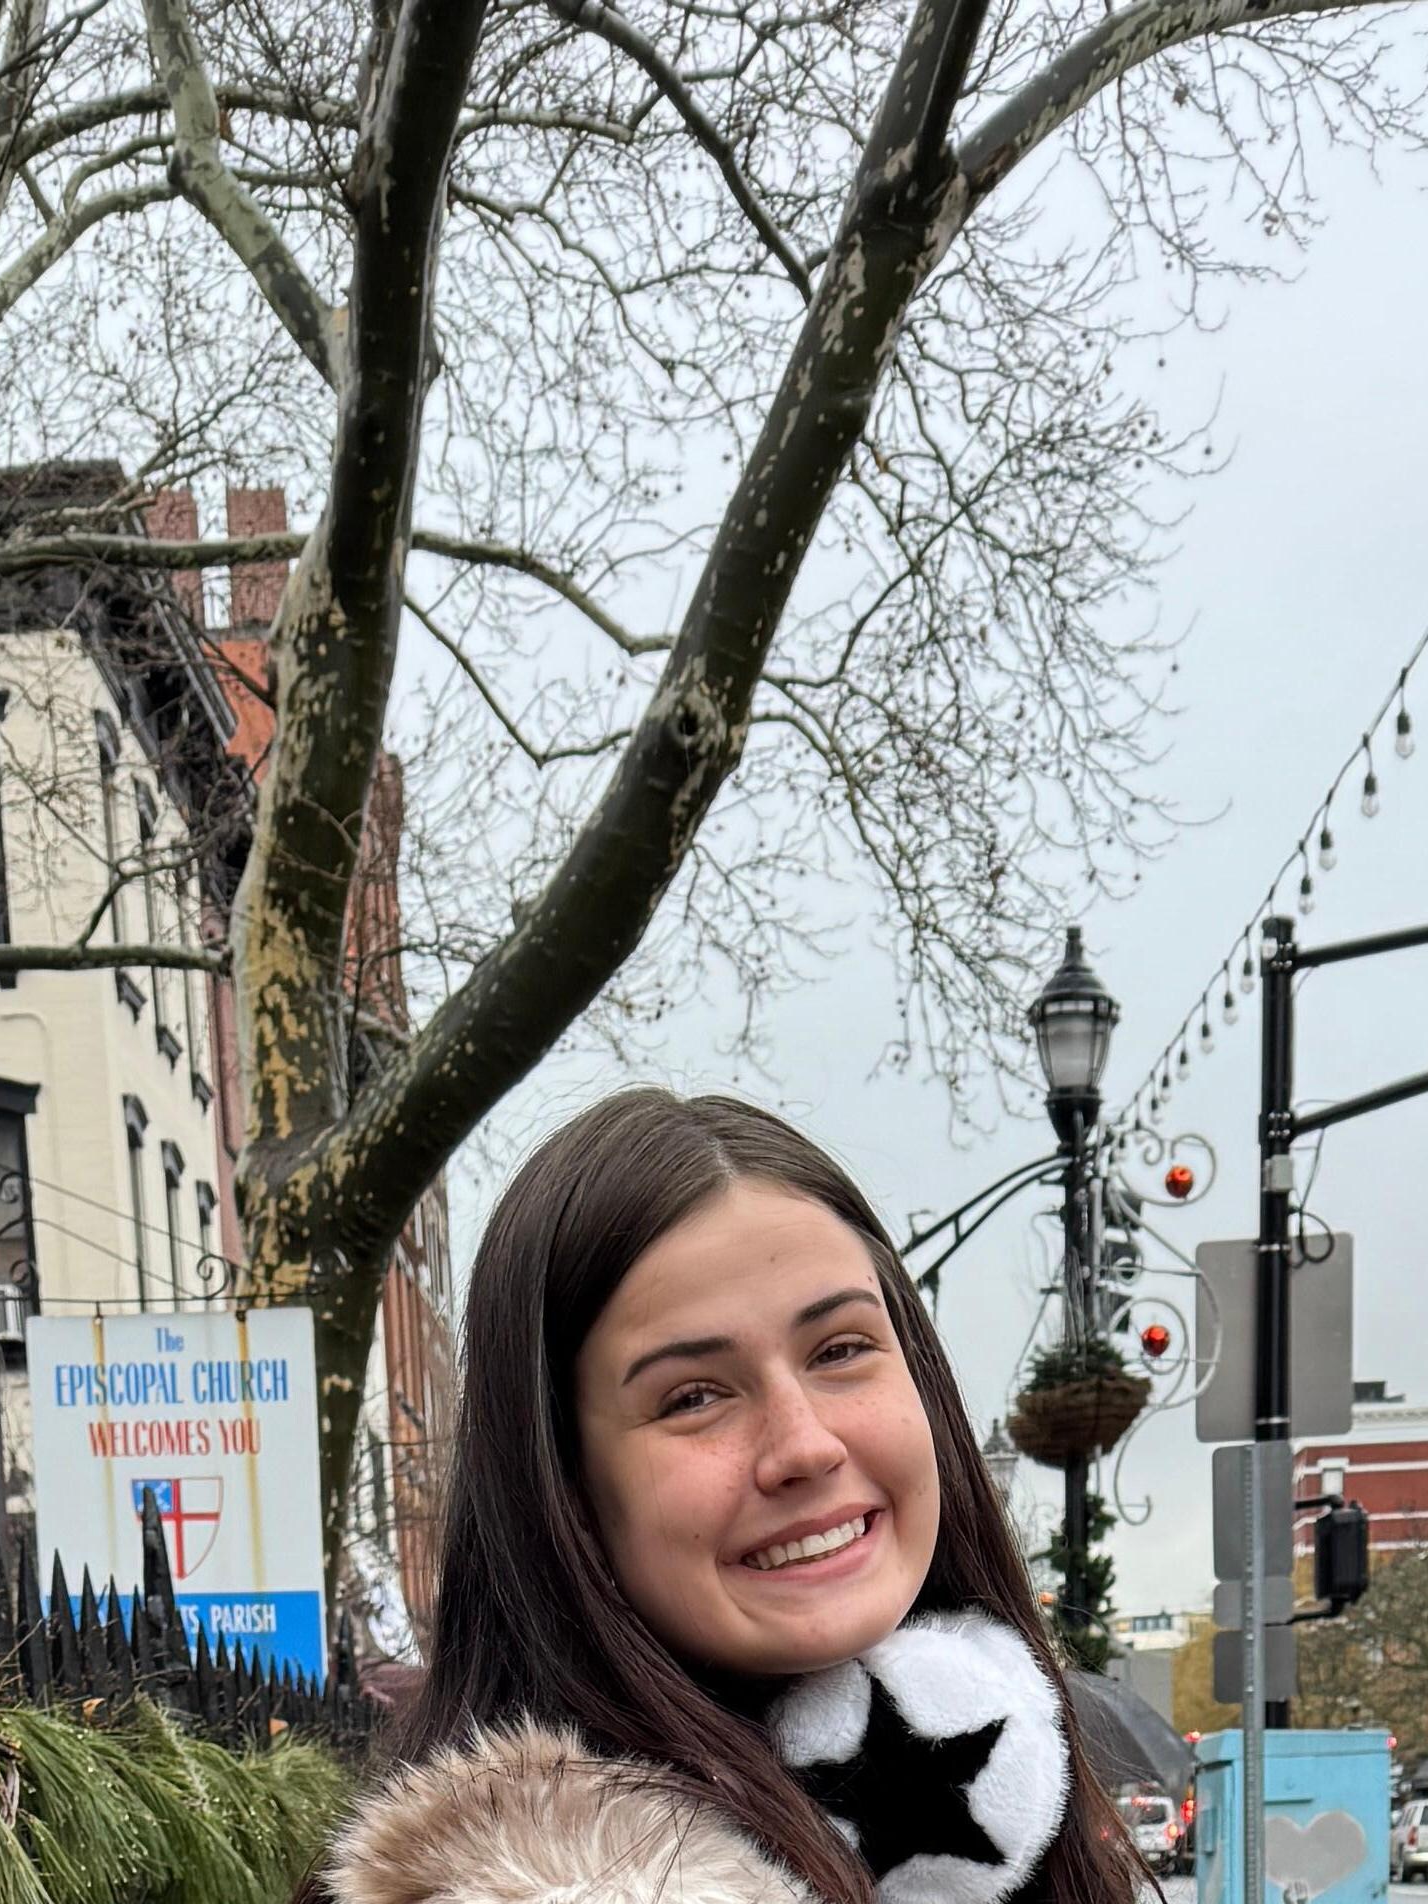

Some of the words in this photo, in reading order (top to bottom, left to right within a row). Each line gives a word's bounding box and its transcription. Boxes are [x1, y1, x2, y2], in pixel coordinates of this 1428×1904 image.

[156, 1328, 184, 1353] The
[54, 1361, 184, 1407] EPISCOPAL
[192, 1358, 289, 1403] CHURCH
[87, 1420, 211, 1458] WELCOMES
[218, 1417, 262, 1455] YOU
[210, 1603, 276, 1633] PARISH
